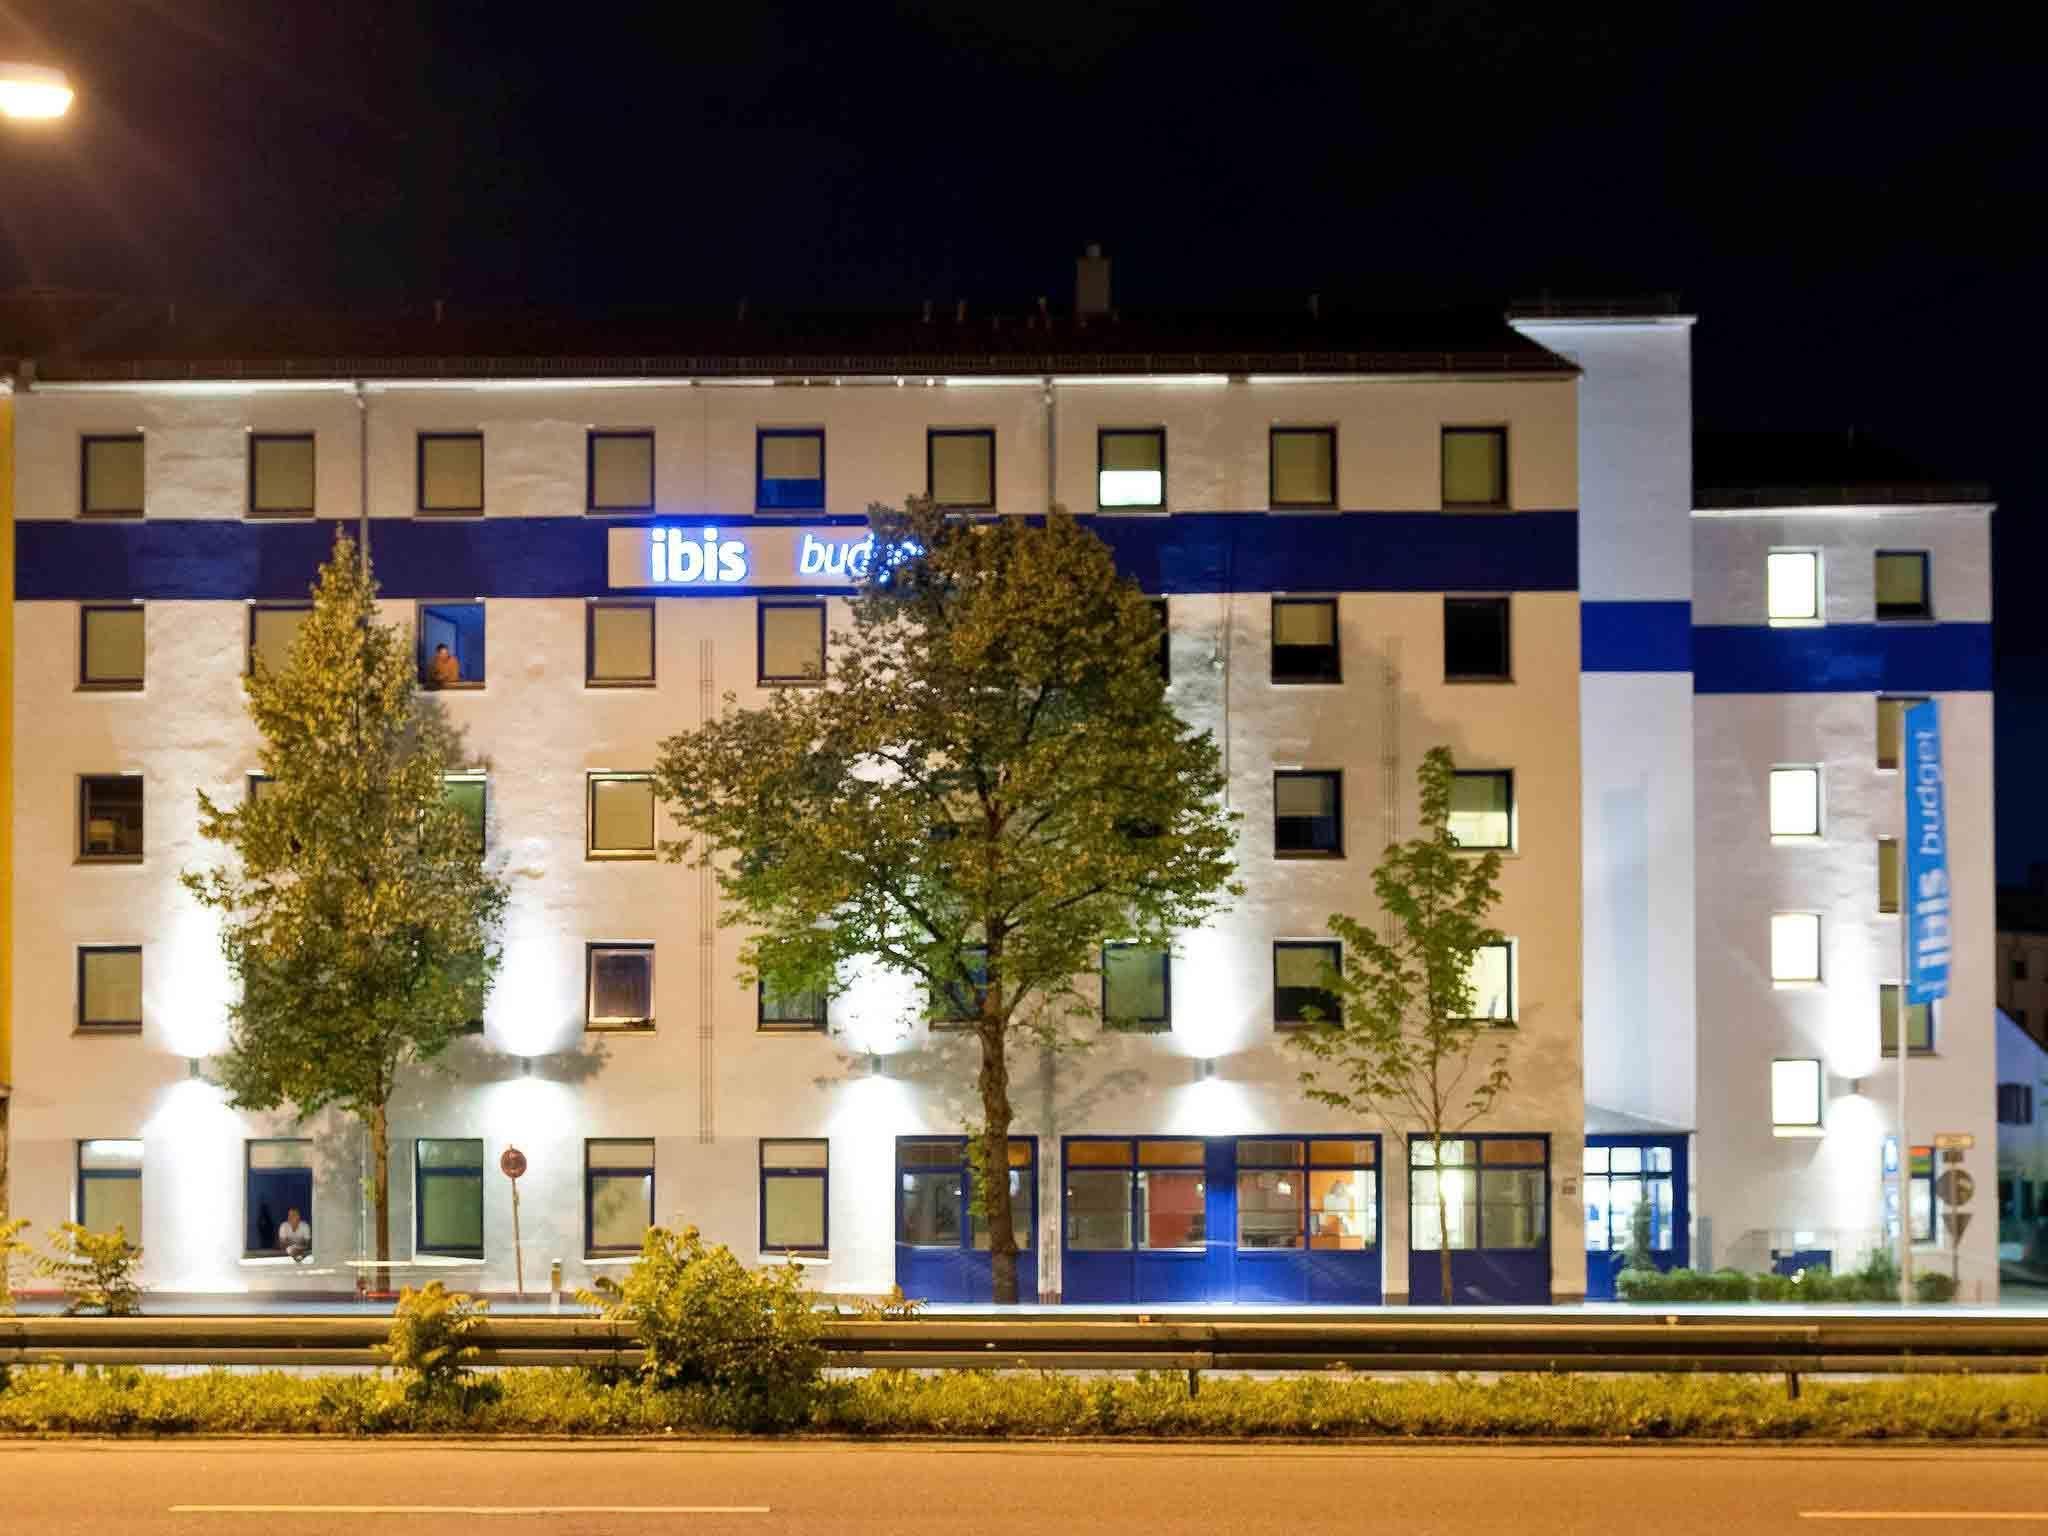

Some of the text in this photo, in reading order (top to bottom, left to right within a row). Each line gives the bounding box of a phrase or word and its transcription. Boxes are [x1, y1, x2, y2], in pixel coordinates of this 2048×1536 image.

[650, 526, 747, 582] ibis
[1915, 731, 1951, 969] ibis budget
